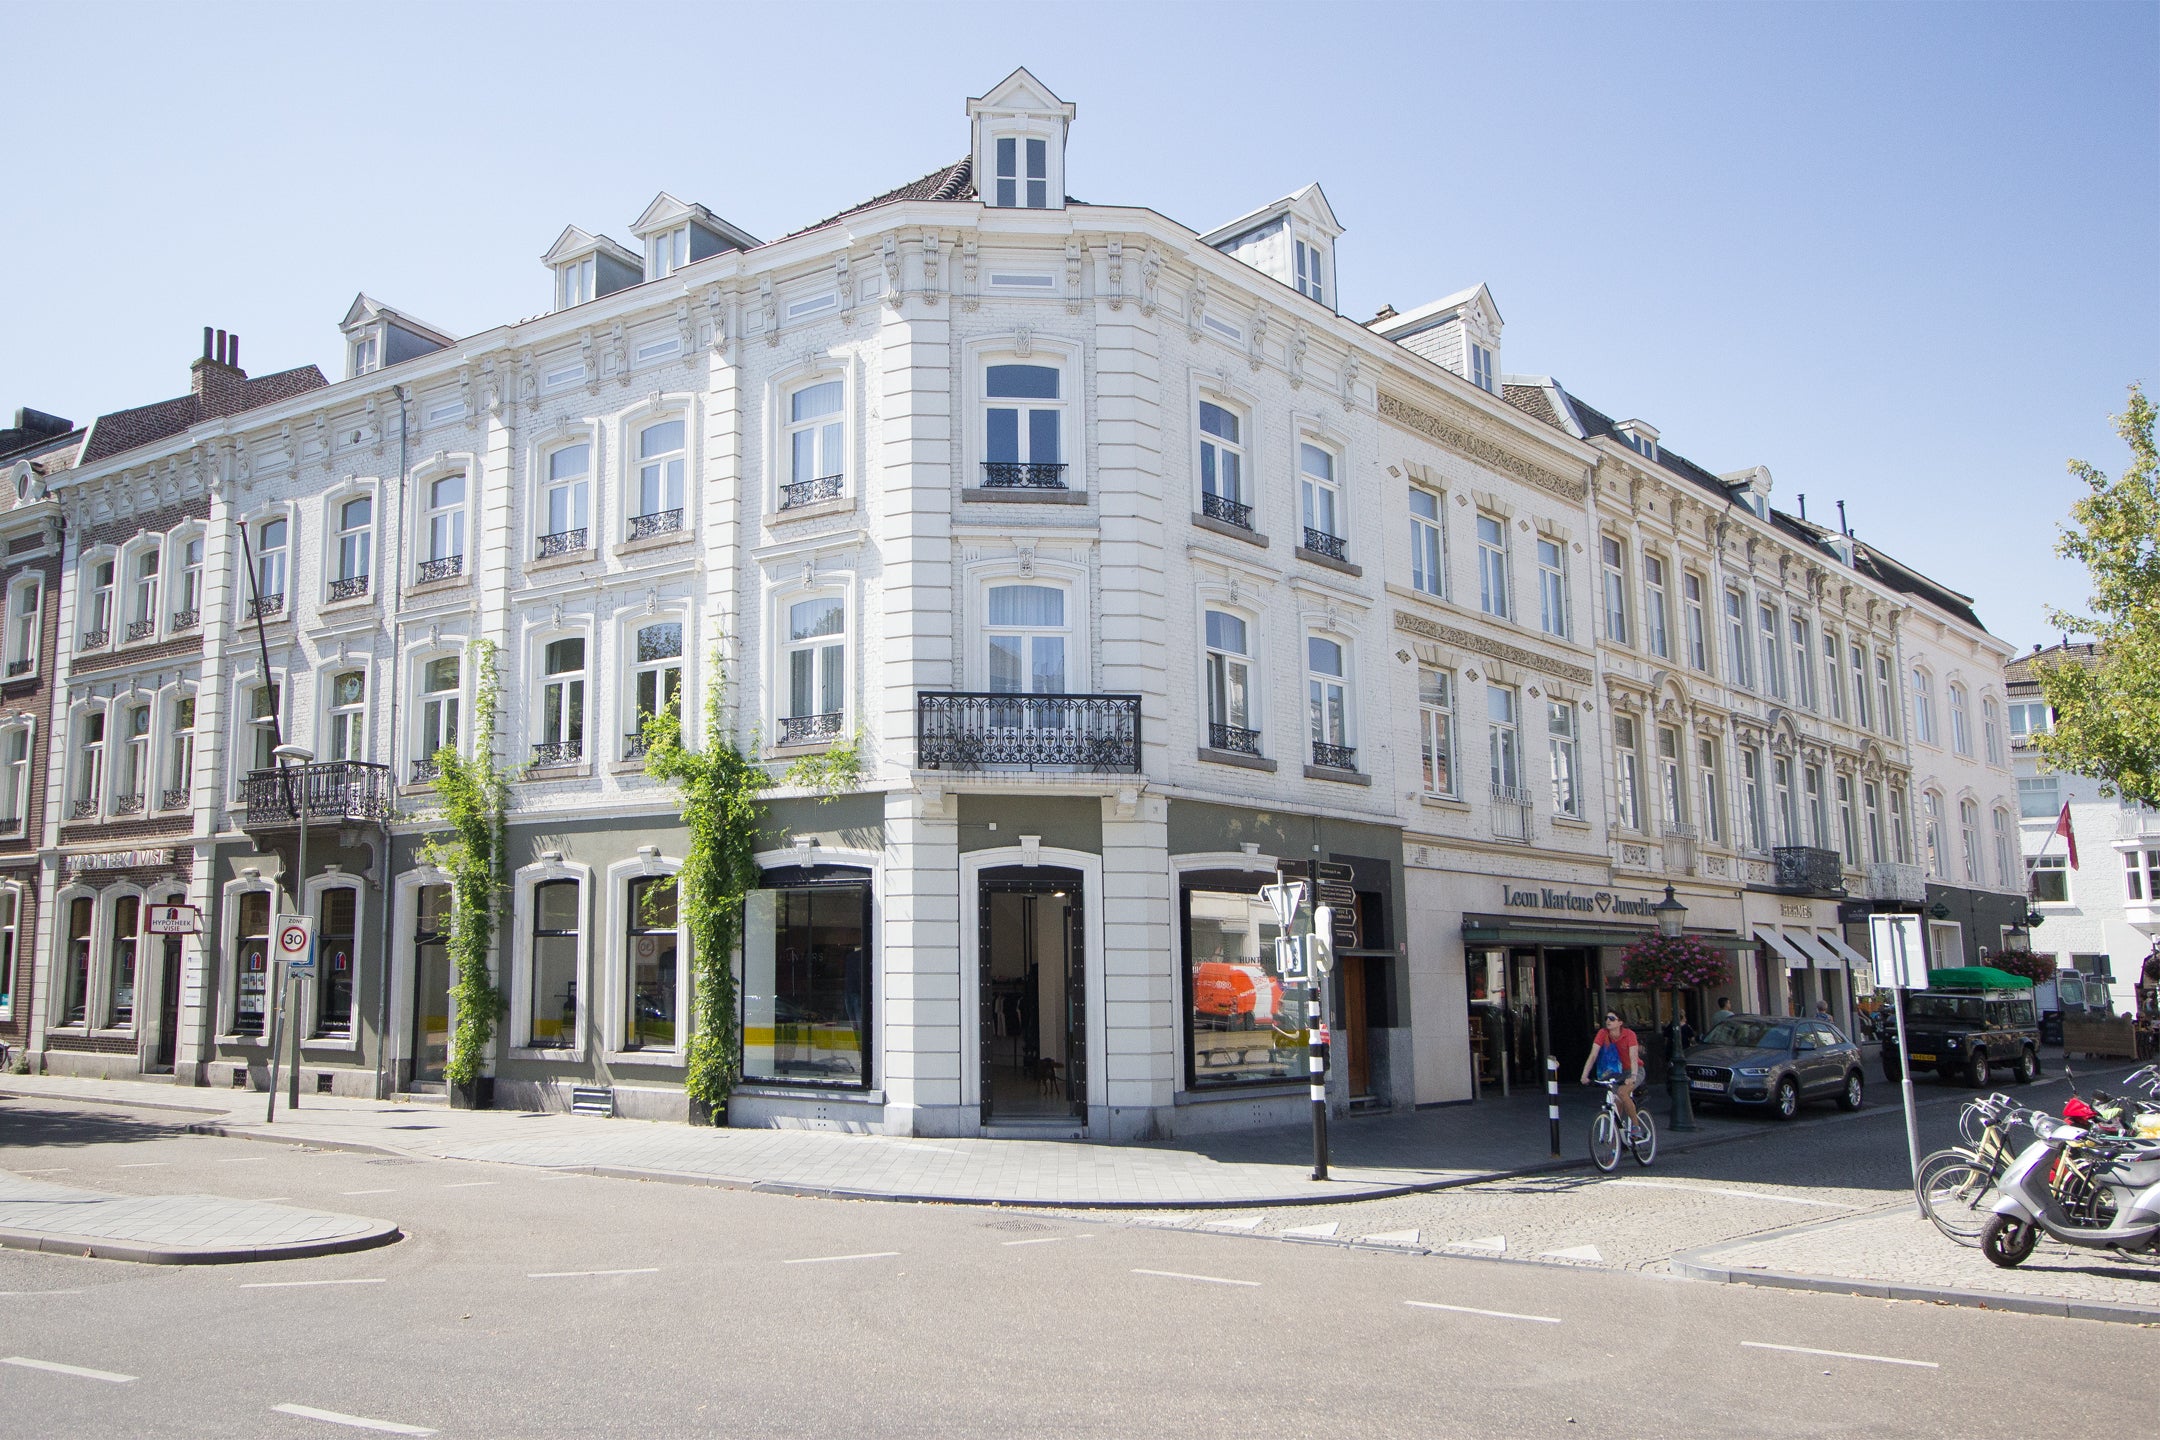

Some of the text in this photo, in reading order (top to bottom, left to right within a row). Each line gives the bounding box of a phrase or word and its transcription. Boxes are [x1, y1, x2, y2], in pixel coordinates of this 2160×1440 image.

[66, 848, 174, 871] HYPOTHEEK VISIE
[1503, 884, 1538, 908] Leon
[1540, 887, 1594, 912] Martens
[152, 919, 192, 927] HYPOTHEEK
[285, 933, 303, 945] 30
